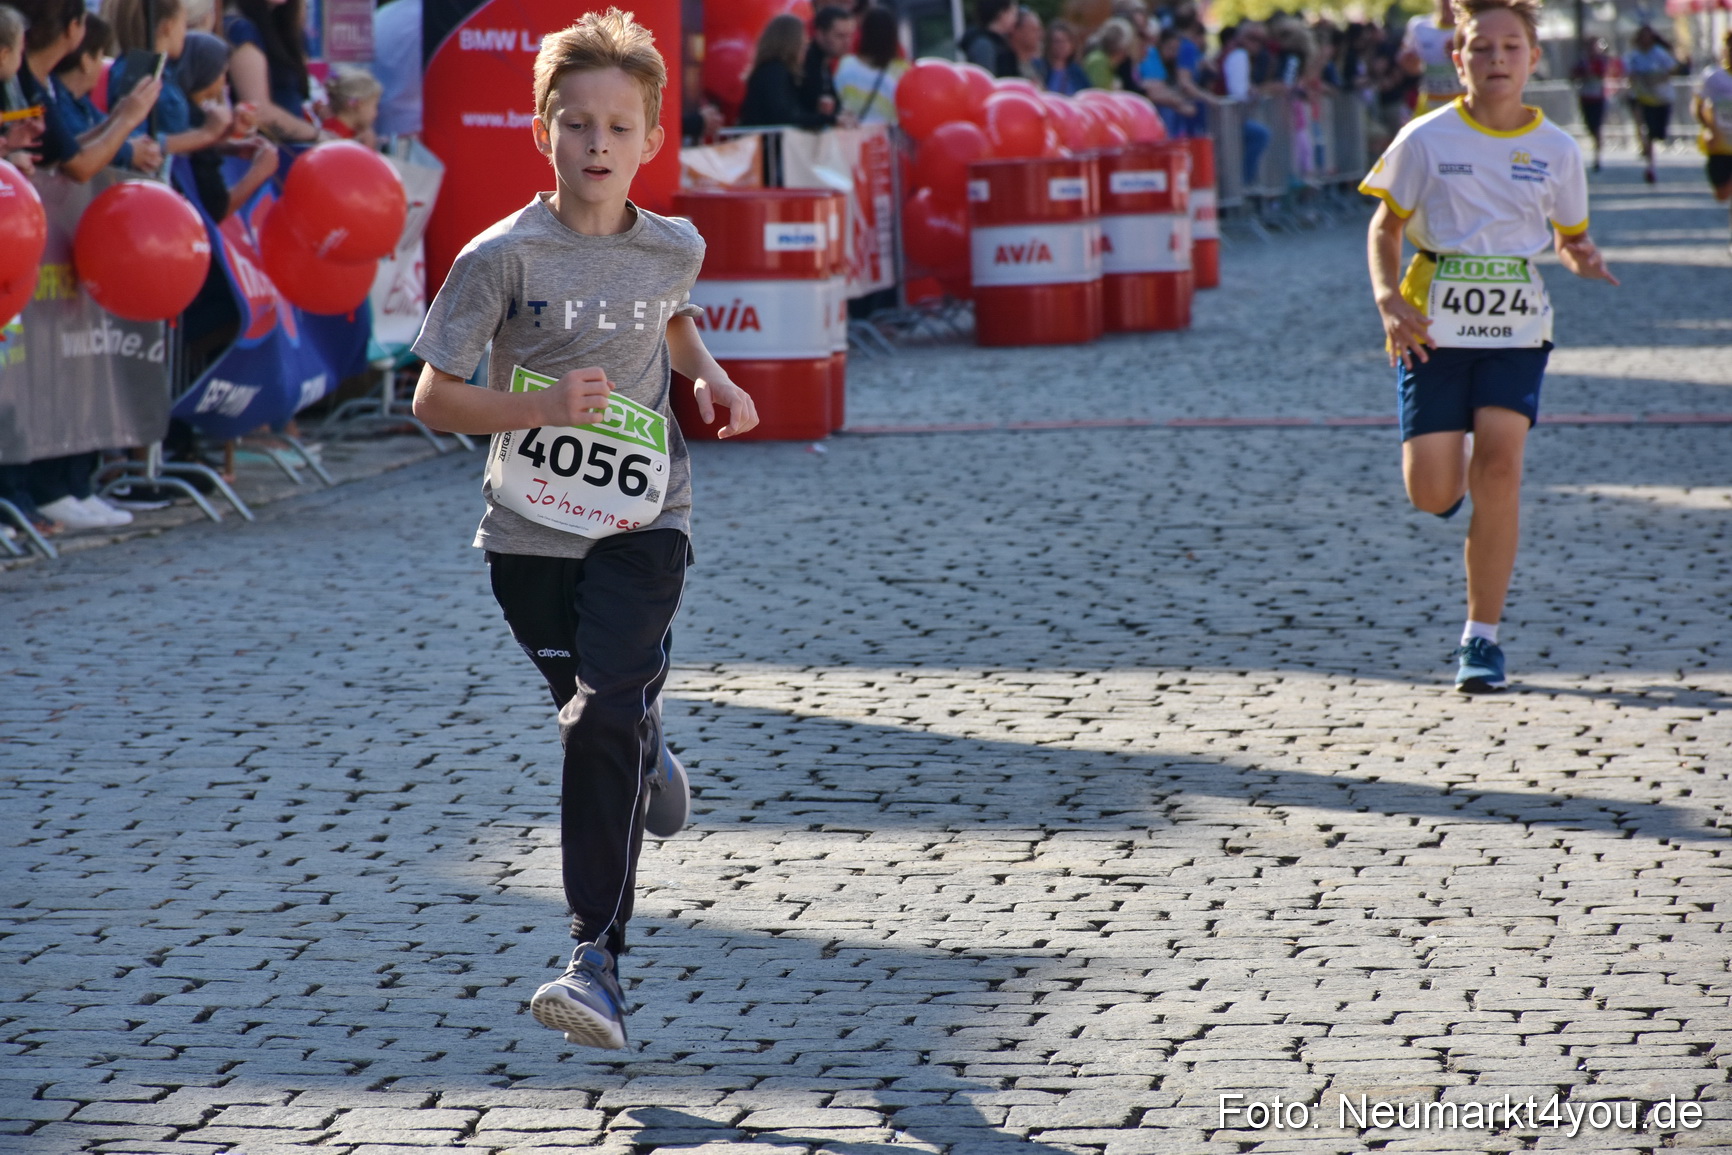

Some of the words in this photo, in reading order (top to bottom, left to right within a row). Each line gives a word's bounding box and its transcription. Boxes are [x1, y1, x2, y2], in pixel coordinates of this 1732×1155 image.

[459, 28, 517, 51] BMW
[521, 30, 543, 52] L
[1441, 258, 1526, 279] BOCK
[1441, 287, 1529, 316] 4024
[1456, 325, 1514, 338] JAKOB
[517, 426, 652, 497] 4056
[525, 477, 641, 532] Johannes
